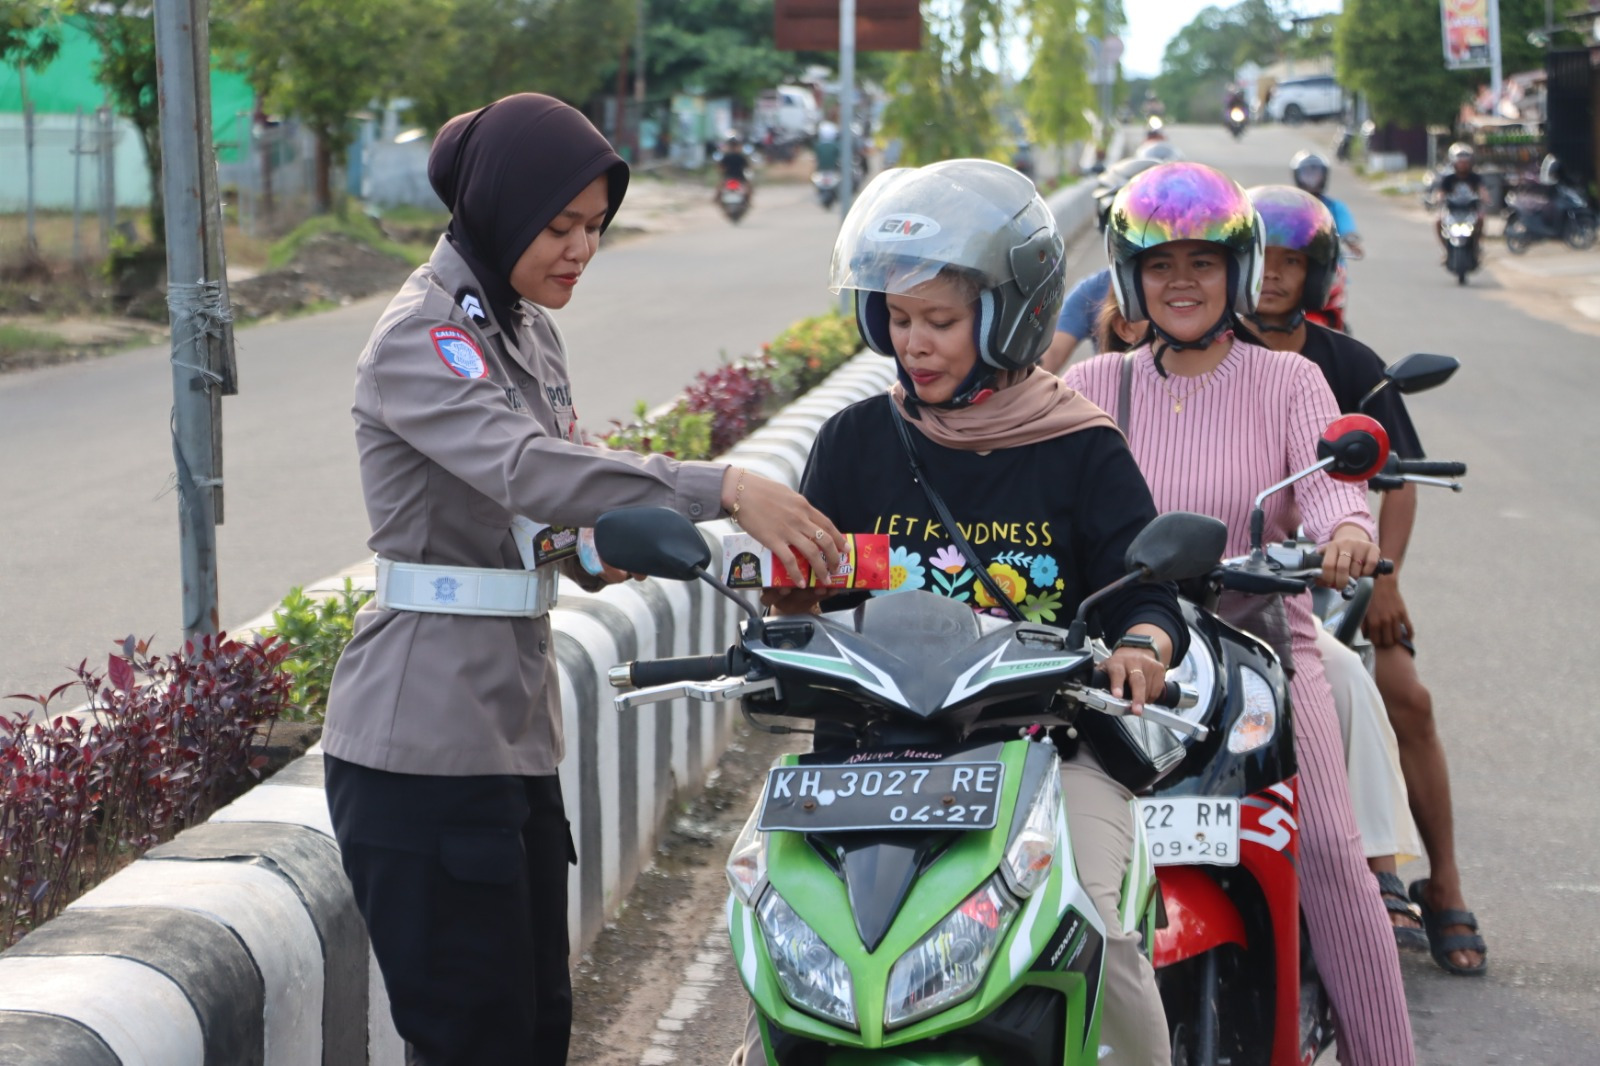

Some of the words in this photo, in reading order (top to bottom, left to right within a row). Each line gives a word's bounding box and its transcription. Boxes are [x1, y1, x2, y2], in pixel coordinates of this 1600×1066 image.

[878, 219, 924, 235] GM
[923, 519, 1052, 547] KNDNESS
[895, 749, 942, 760] Motor
[773, 771, 821, 799] KH
[837, 769, 930, 797] 3027
[952, 767, 997, 793] RE
[1197, 803, 1232, 827] RM
[1050, 919, 1079, 967] HONDA
